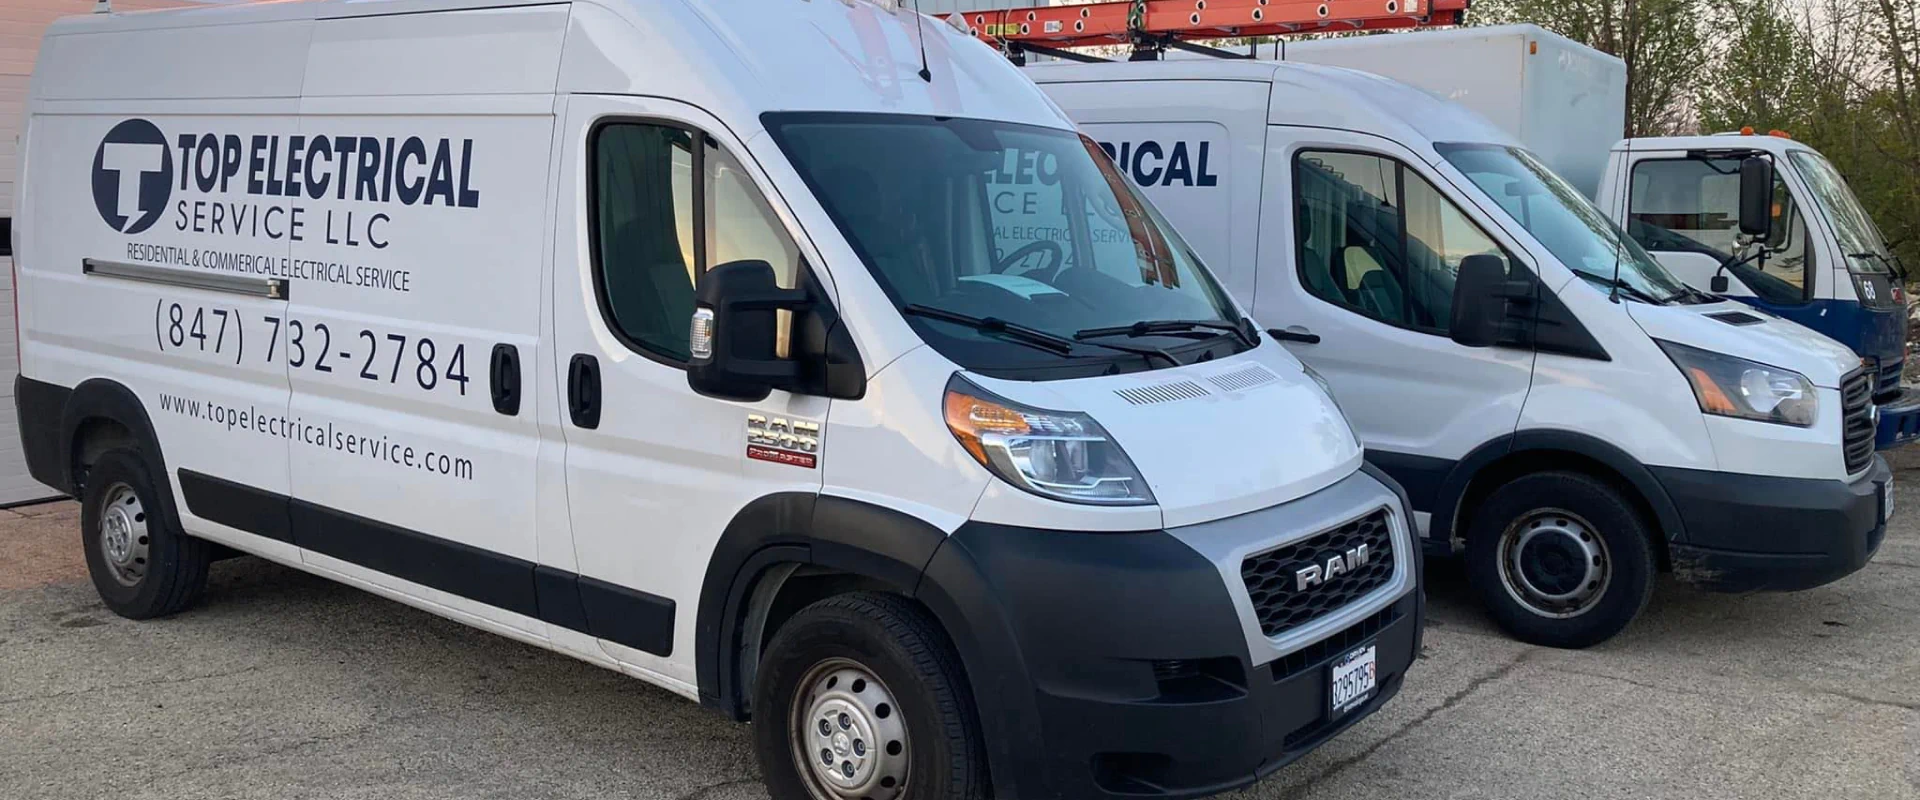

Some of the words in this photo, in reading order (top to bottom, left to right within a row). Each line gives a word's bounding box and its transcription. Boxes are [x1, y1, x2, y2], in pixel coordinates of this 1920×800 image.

[178, 133, 242, 193] TOP
[247, 134, 480, 209] ELECTRICAL
[175, 200, 305, 242] SERVICE
[326, 210, 391, 249] LLC
[1013, 226, 1071, 241] ELECTRIC
[127, 243, 190, 267] RESIDENTIAL
[191, 249, 200, 267] &
[202, 250, 278, 276] COMMERICAL
[280, 258, 353, 285] ELECTRICAL
[355, 267, 410, 292] SERVICE
[155, 298, 243, 365] (847)
[263, 316, 470, 396] 732-2784
[159, 392, 473, 481] www.topelectricalservice.com
[748, 413, 819, 437] RAM
[1296, 543, 1369, 592] RAM
